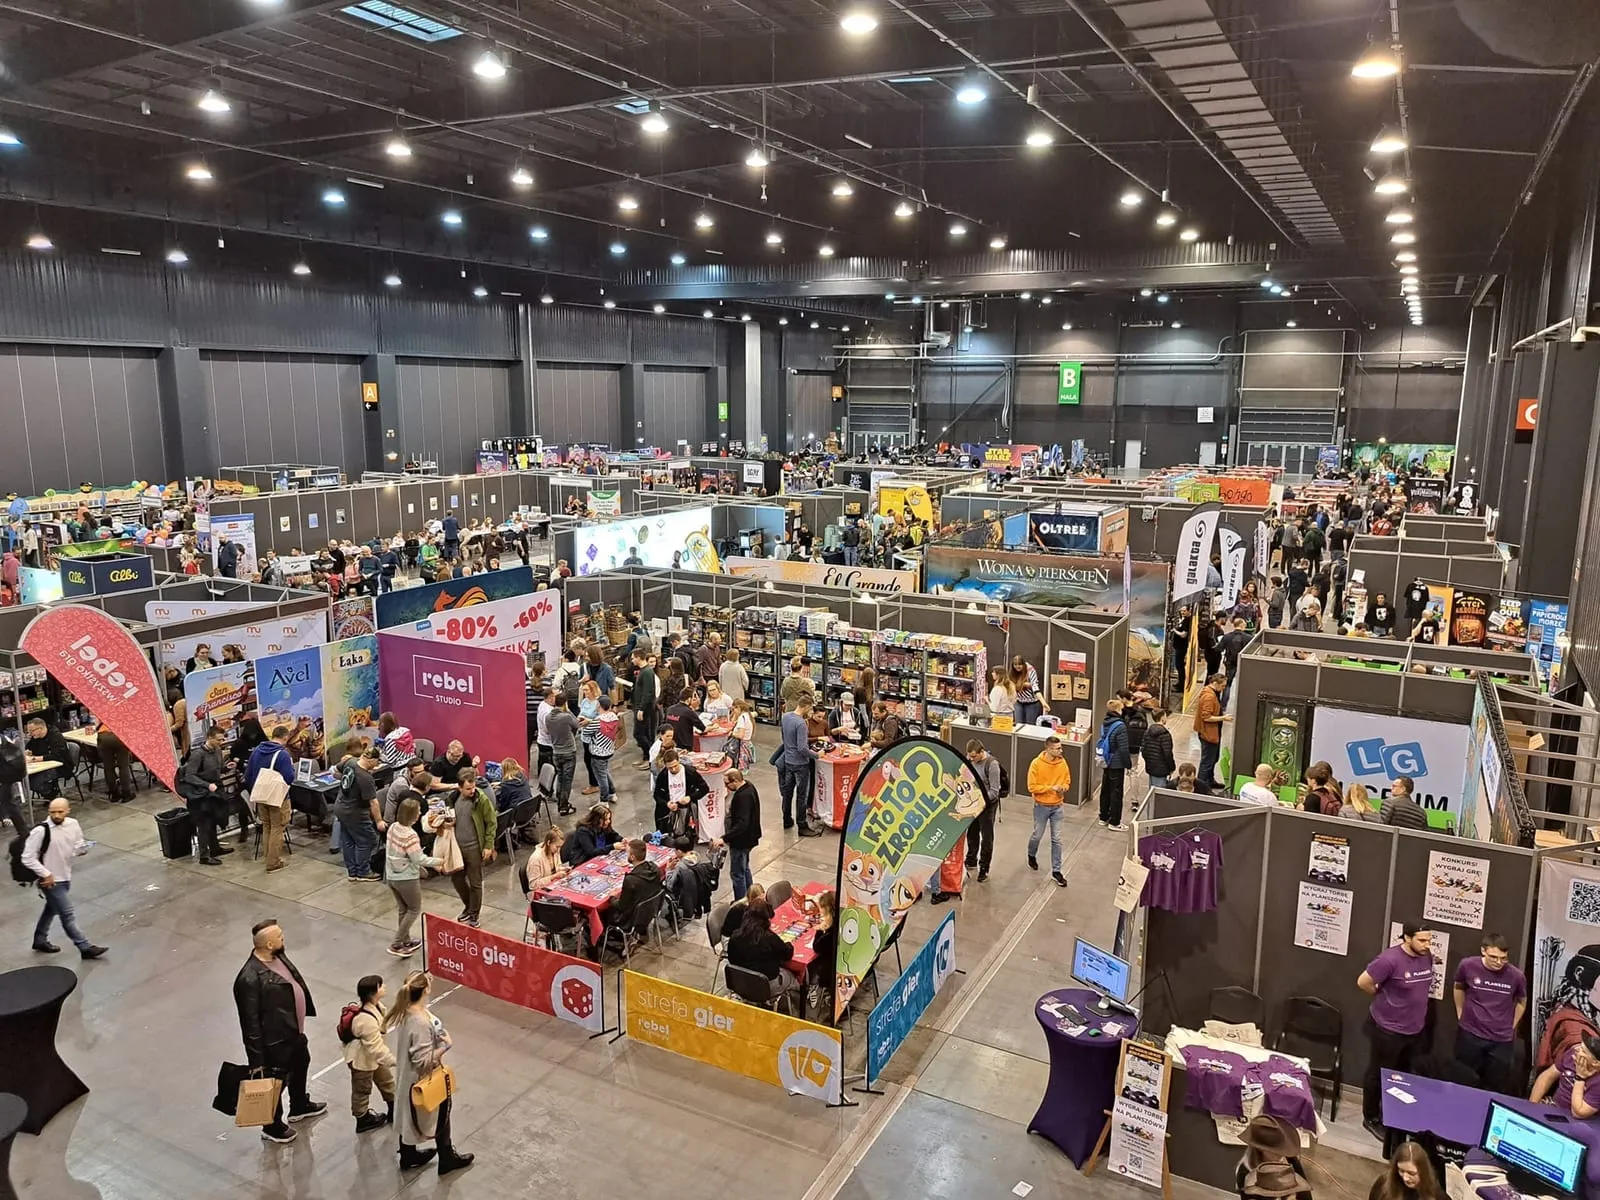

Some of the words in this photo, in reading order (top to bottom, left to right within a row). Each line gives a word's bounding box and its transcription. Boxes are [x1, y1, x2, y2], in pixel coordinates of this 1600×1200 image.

[1063, 368, 1076, 388] B
[366, 386, 375, 399] A
[977, 558, 1023, 577] WOJNA
[1038, 563, 1111, 586] PIERŚCIEŃ
[1186, 540, 1201, 585] galakta
[823, 567, 843, 587] El
[845, 570, 901, 592] Grande
[512, 597, 553, 630] -60%
[1500, 599, 1521, 608] KEEP
[436, 615, 498, 641] -80%
[269, 663, 310, 690] Avel
[423, 671, 474, 694] rebel
[200, 690, 243, 713] Francisco
[209, 686, 230, 698] San
[435, 694, 462, 706] STUDIO
[841, 775, 851, 806] rebel
[706, 790, 716, 820] rebel
[863, 809, 895, 843] KTO
[879, 779, 916, 812] TO
[925, 828, 944, 850] rebel
[1435, 863, 1464, 873] WYGRAJ
[1441, 856, 1478, 867] KONKURS!
[437, 930, 478, 956] strefa
[482, 945, 516, 968] gier
[438, 956, 464, 973] rebel
[638, 989, 688, 1018] strefa
[693, 1005, 735, 1032] gier
[875, 994, 901, 1036] strefa
[902, 969, 920, 1007] gier
[638, 1018, 670, 1035] rebel
[1115, 1107, 1125, 1115] NA
